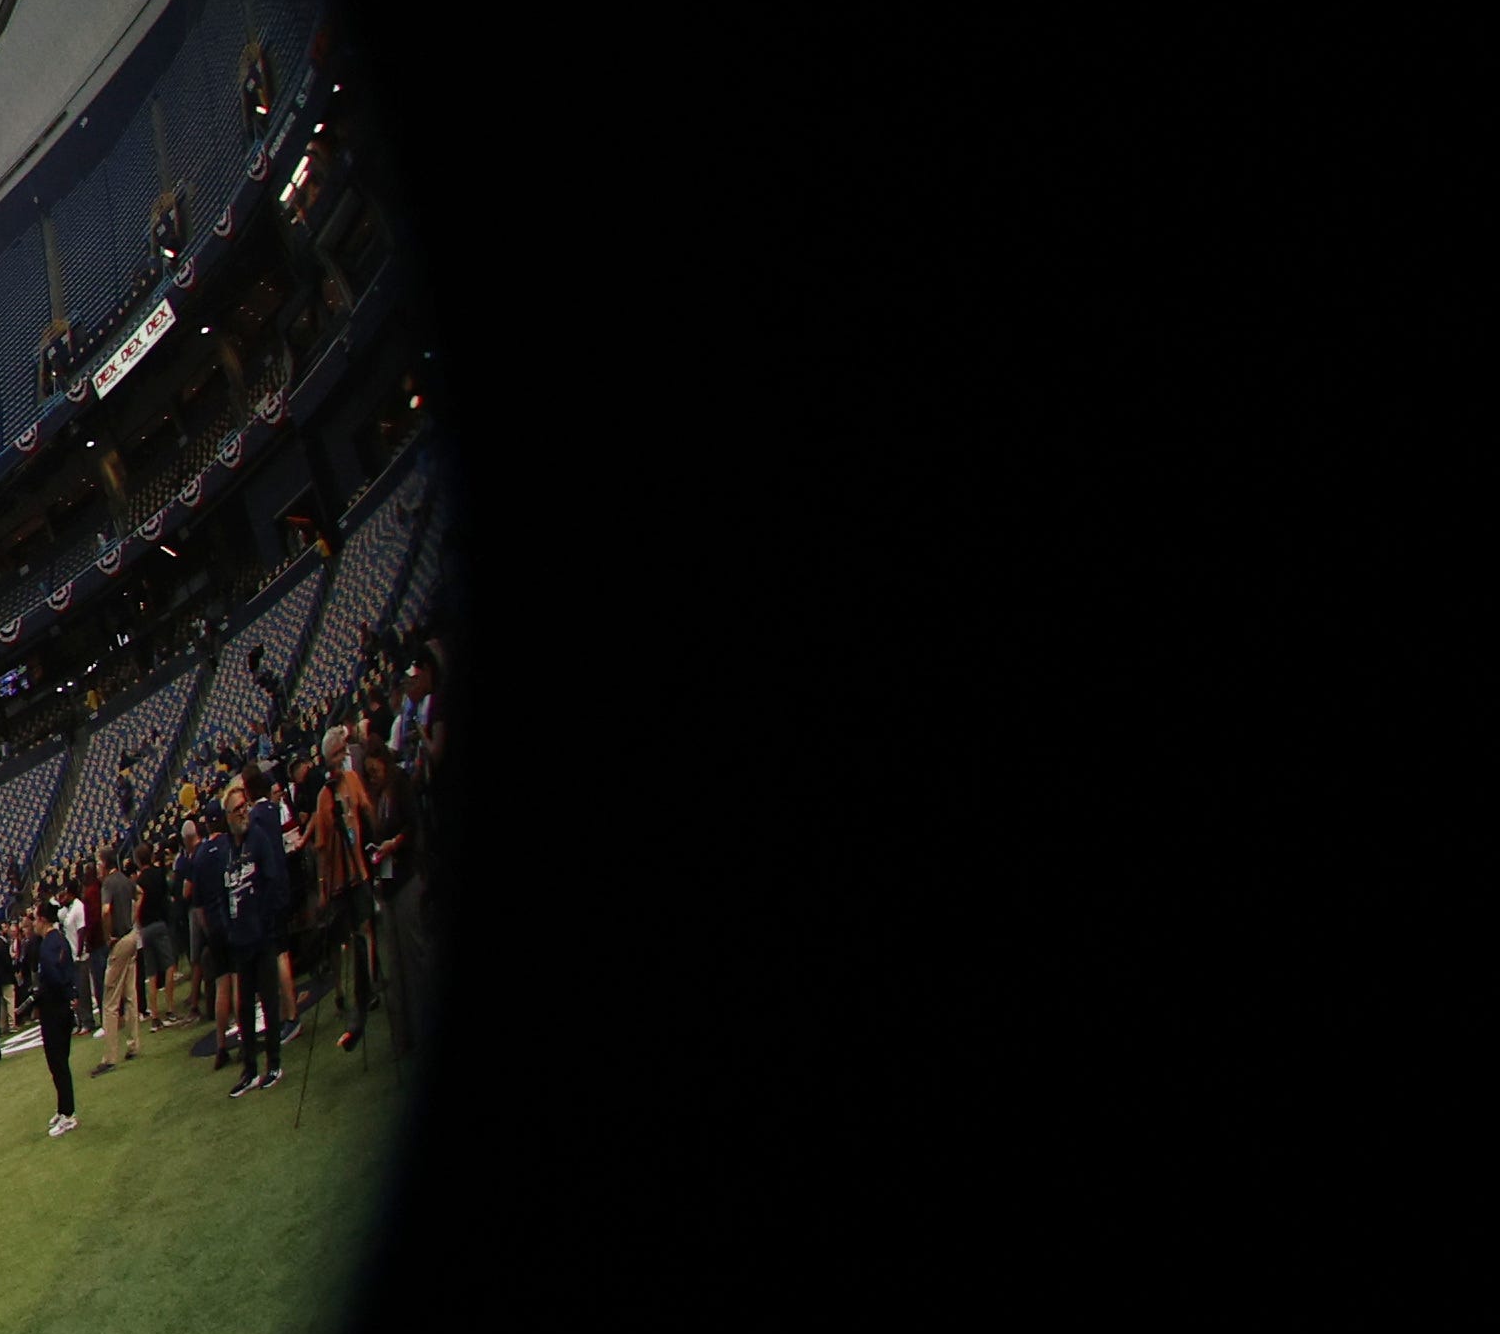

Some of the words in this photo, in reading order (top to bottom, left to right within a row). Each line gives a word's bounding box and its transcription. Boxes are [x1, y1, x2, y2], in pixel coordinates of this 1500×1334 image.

[146, 305, 168, 335] DEX
[121, 333, 142, 362] DEX
[96, 360, 118, 389] DEX
